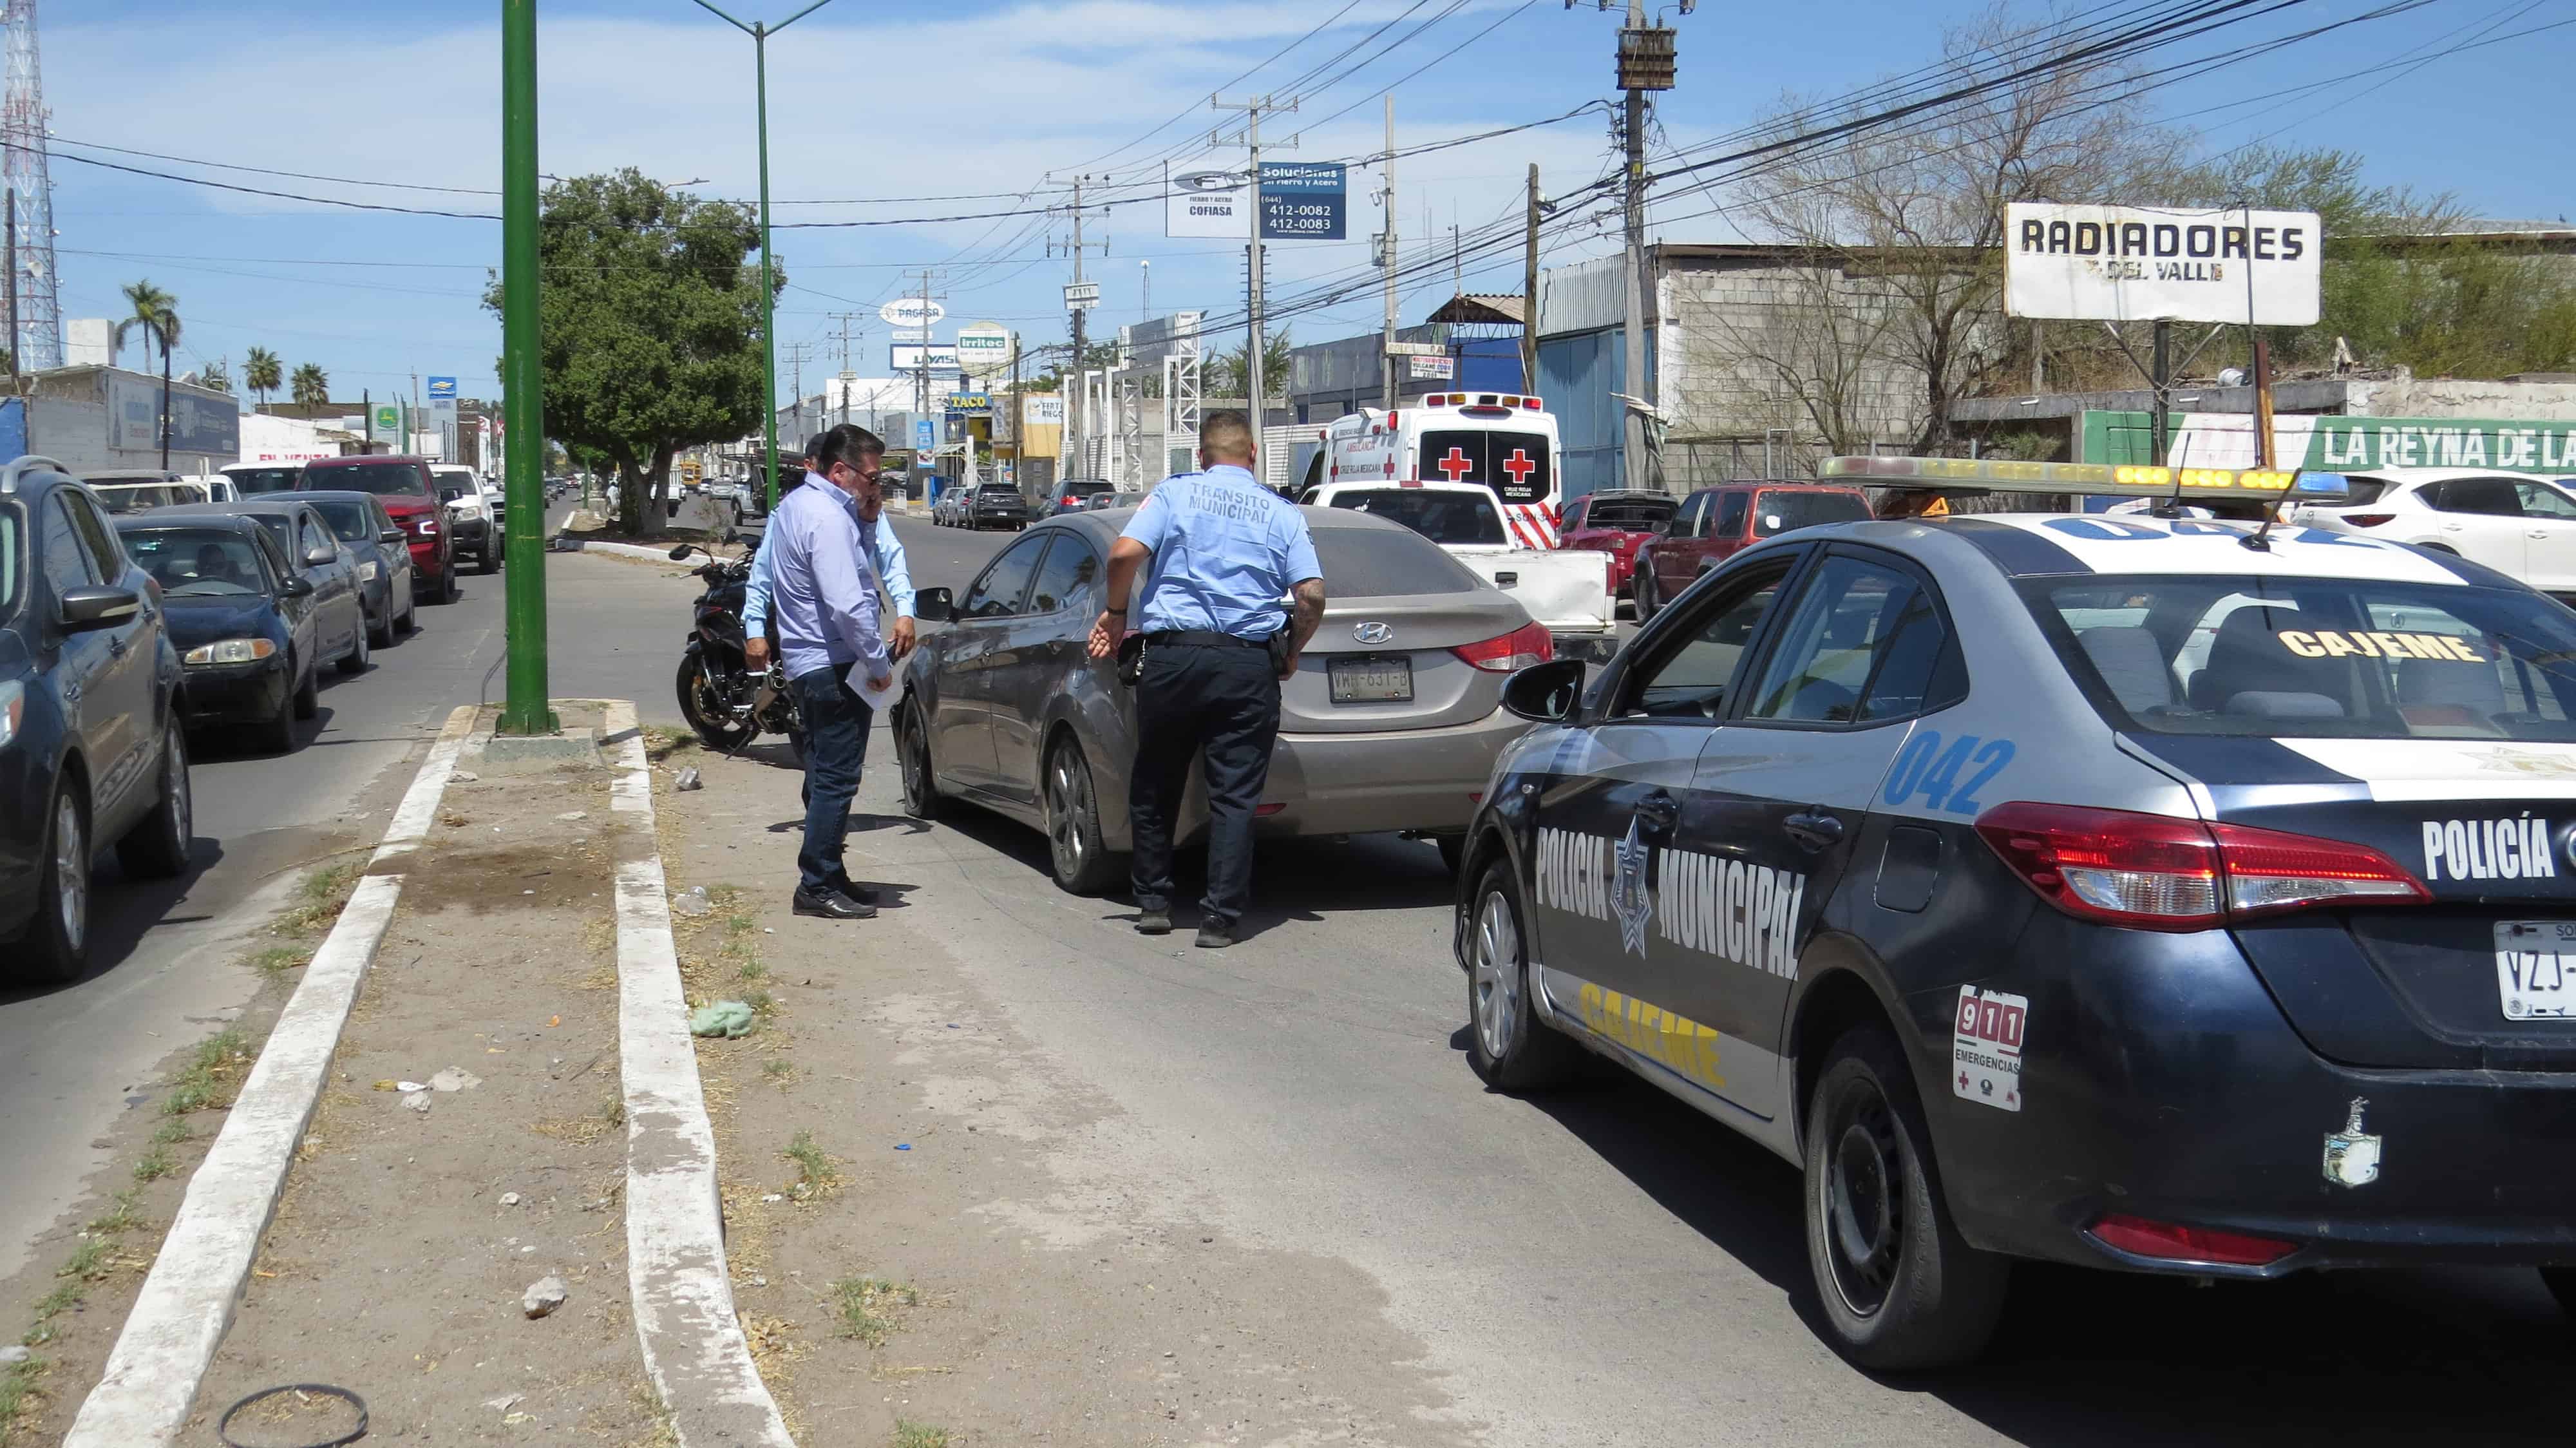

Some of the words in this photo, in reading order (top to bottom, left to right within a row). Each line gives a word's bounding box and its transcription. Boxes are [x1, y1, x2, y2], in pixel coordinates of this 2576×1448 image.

[1263, 167, 1338, 178] Soluciones
[1189, 205, 1233, 216] COFIASA
[1260, 195, 1282, 204] (644)
[1269, 205, 1331, 216] 412-0082
[1269, 218, 1331, 230] 412-0083
[2022, 218, 2304, 261] RADIADORES
[2108, 260, 2148, 281] DEL
[961, 338, 1003, 347] irritec
[951, 396, 987, 408] TACO
[2324, 425, 2369, 465] LA
[2378, 426, 2487, 466] REYNA
[2496, 428, 2536, 468] DE
[1188, 495, 1269, 524] MUNICIPAL
[1191, 482, 1270, 511] TRANSITO
[2277, 629, 2487, 664] CAJEME
[1884, 730, 2016, 816] 042
[2422, 810, 2556, 881] POLICÍA
[1536, 826, 1608, 921] POLICIA
[1657, 847, 1806, 982] MUNICIPAL
[1579, 983, 1727, 1087] CAJEME
[1962, 1003, 2018, 1041] 911
[1955, 1047, 2021, 1075] EMERGENCIAS
